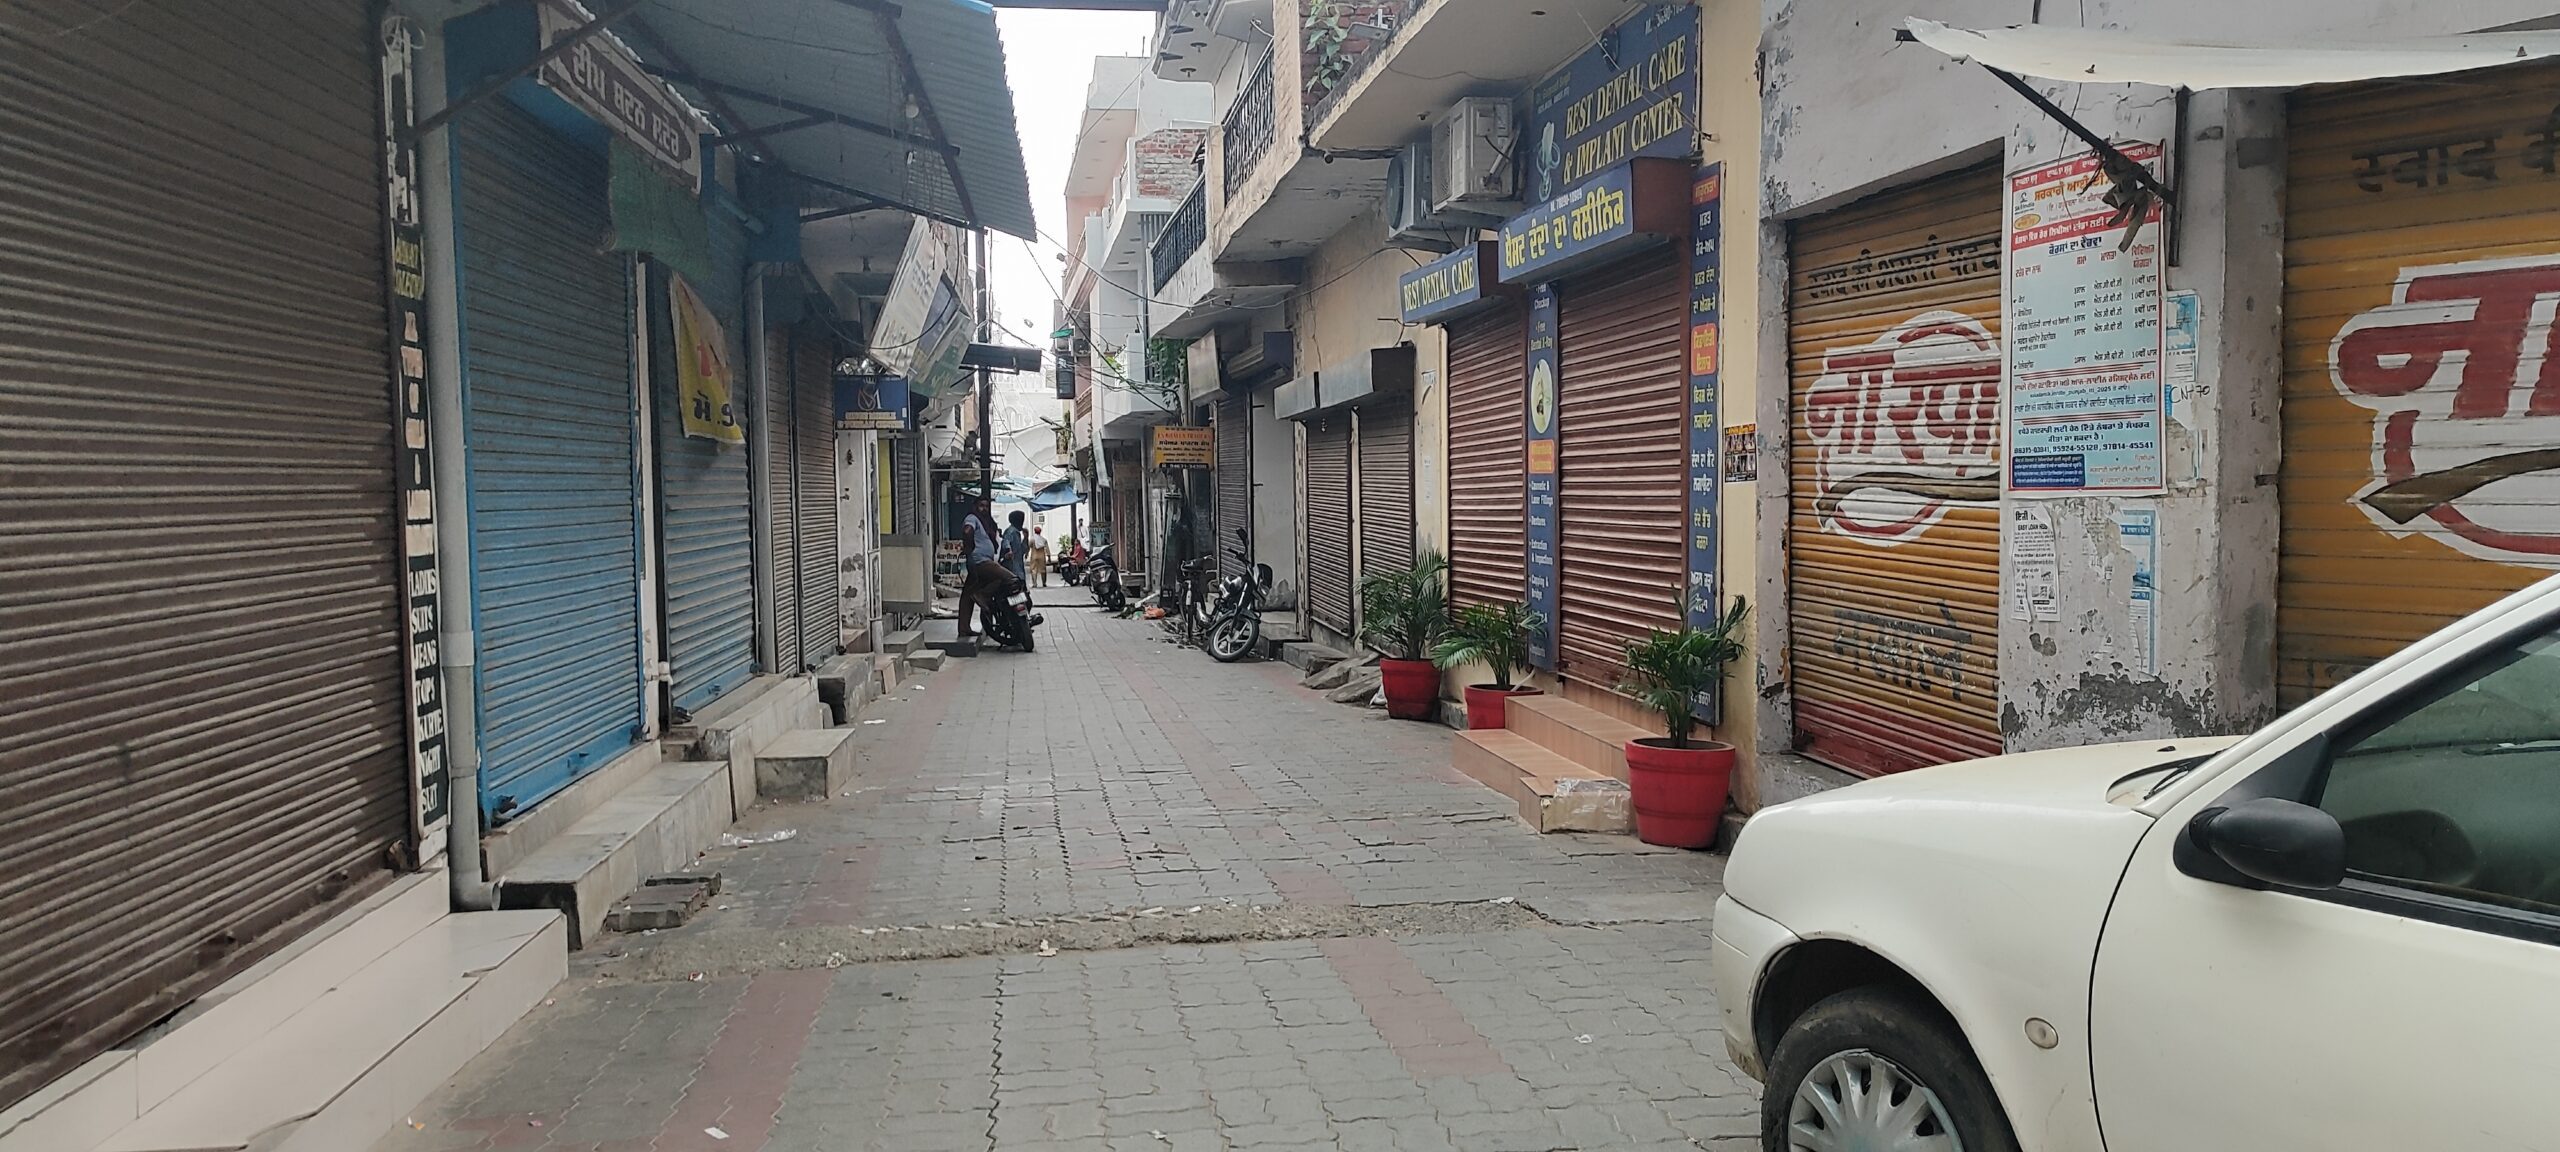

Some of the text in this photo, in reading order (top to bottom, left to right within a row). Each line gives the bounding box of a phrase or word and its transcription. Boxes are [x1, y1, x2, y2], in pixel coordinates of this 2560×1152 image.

[1565, 94, 1594, 139] BEST
[1596, 63, 1643, 121] DENTAL
[1649, 35, 1686, 91] CARE
[1563, 152, 1574, 185] &
[1576, 121, 1628, 179] IMPLANT
[1631, 92, 1684, 151] CENTER
[1553, 214, 1568, 249] ਦਾ
[1572, 186, 1624, 242] ਕਲੀਨਿਕ
[2049, 236, 2102, 255] ਕੋਰਸਾਂ ਦਾ ਵੇਰਵਾ
[1403, 257, 1475, 312] BEST DENTAL CARE
[2140, 371, 2155, 380] ਲਈ
[2053, 424, 2067, 433] ਲਈ
[2126, 420, 2150, 429] ਸੰਪਰਕ
[413, 639, 437, 669] JEANS
[415, 676, 435, 706] TOPS
[421, 783, 438, 814] SUIT
